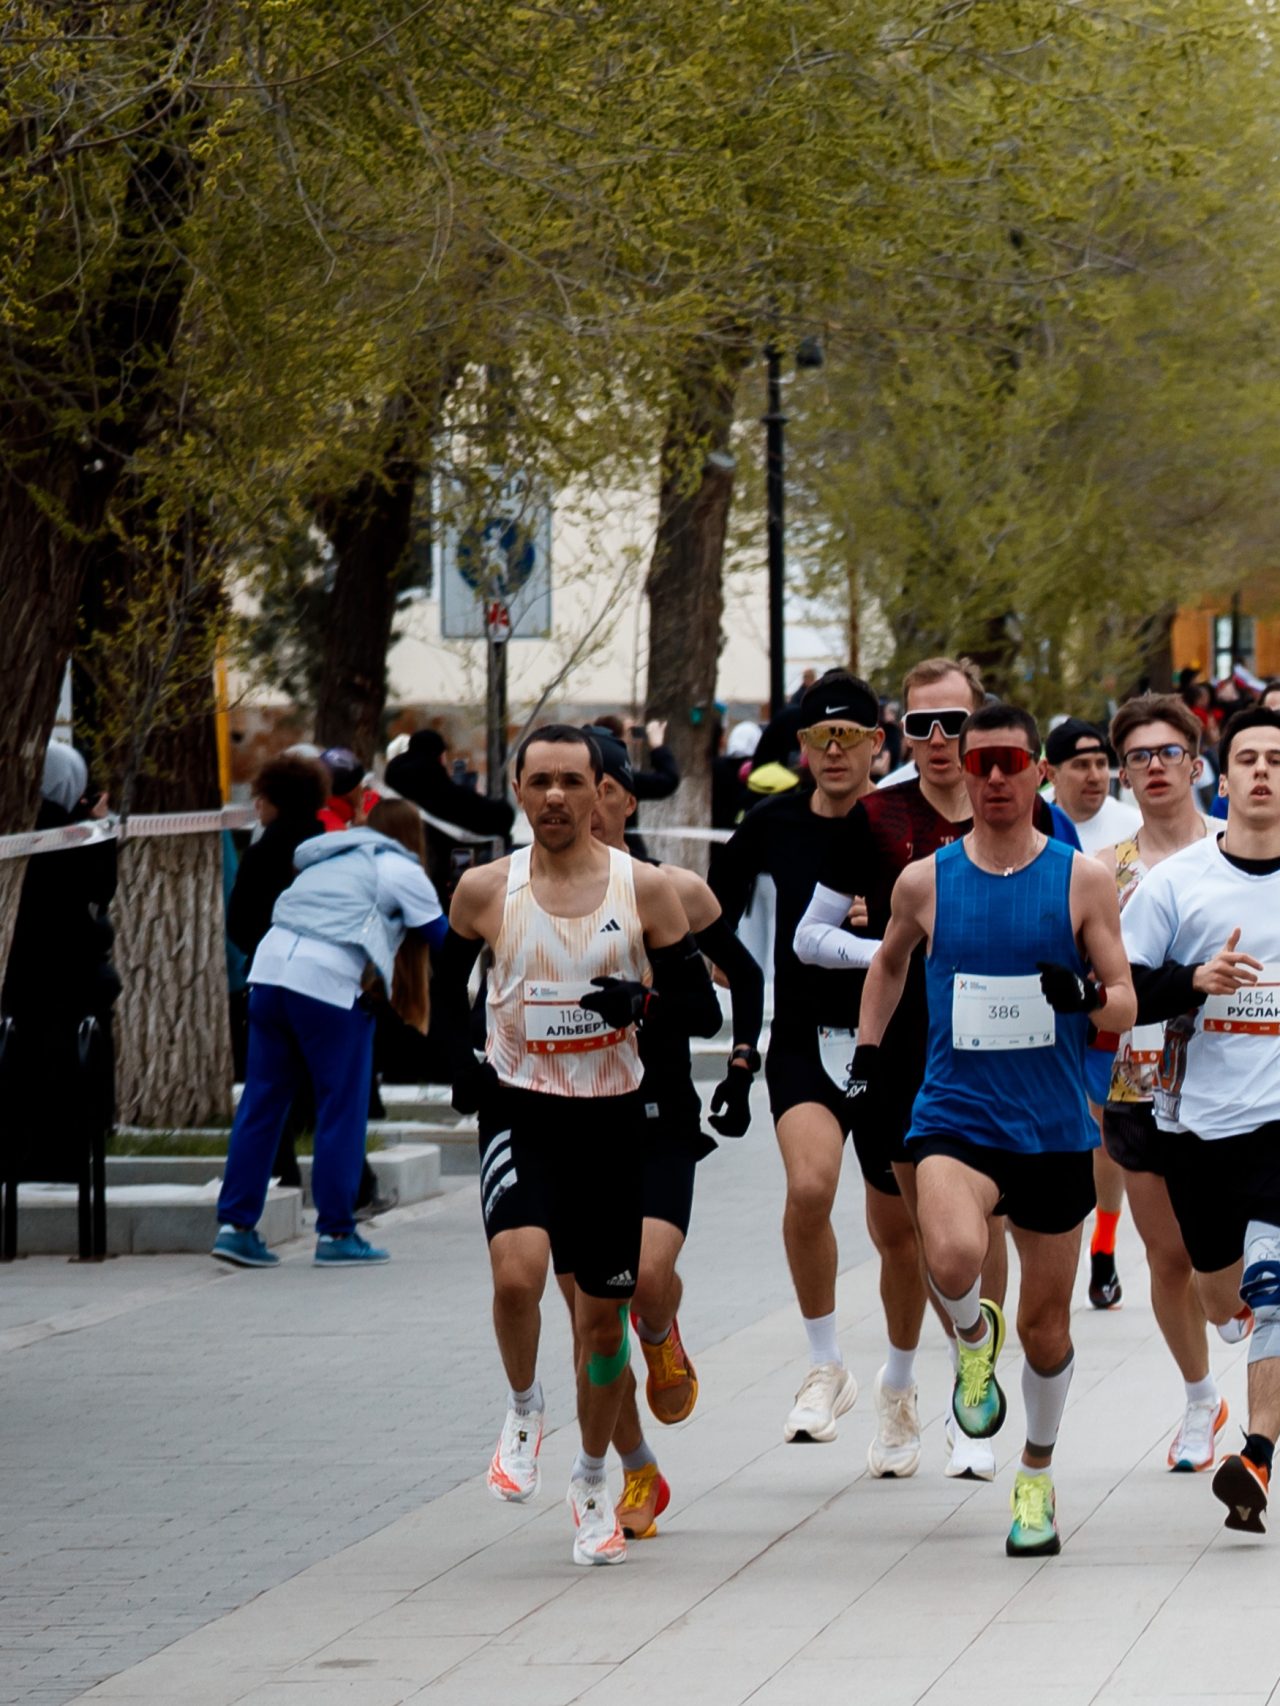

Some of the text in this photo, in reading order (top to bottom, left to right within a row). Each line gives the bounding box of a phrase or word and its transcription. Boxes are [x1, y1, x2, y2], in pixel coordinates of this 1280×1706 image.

[1237, 991, 1274, 1005] 1454
[560, 1009, 594, 1023] 1166
[988, 1005, 1020, 1019] 386
[546, 1021, 608, 1036] АЛЬБЕРТ
